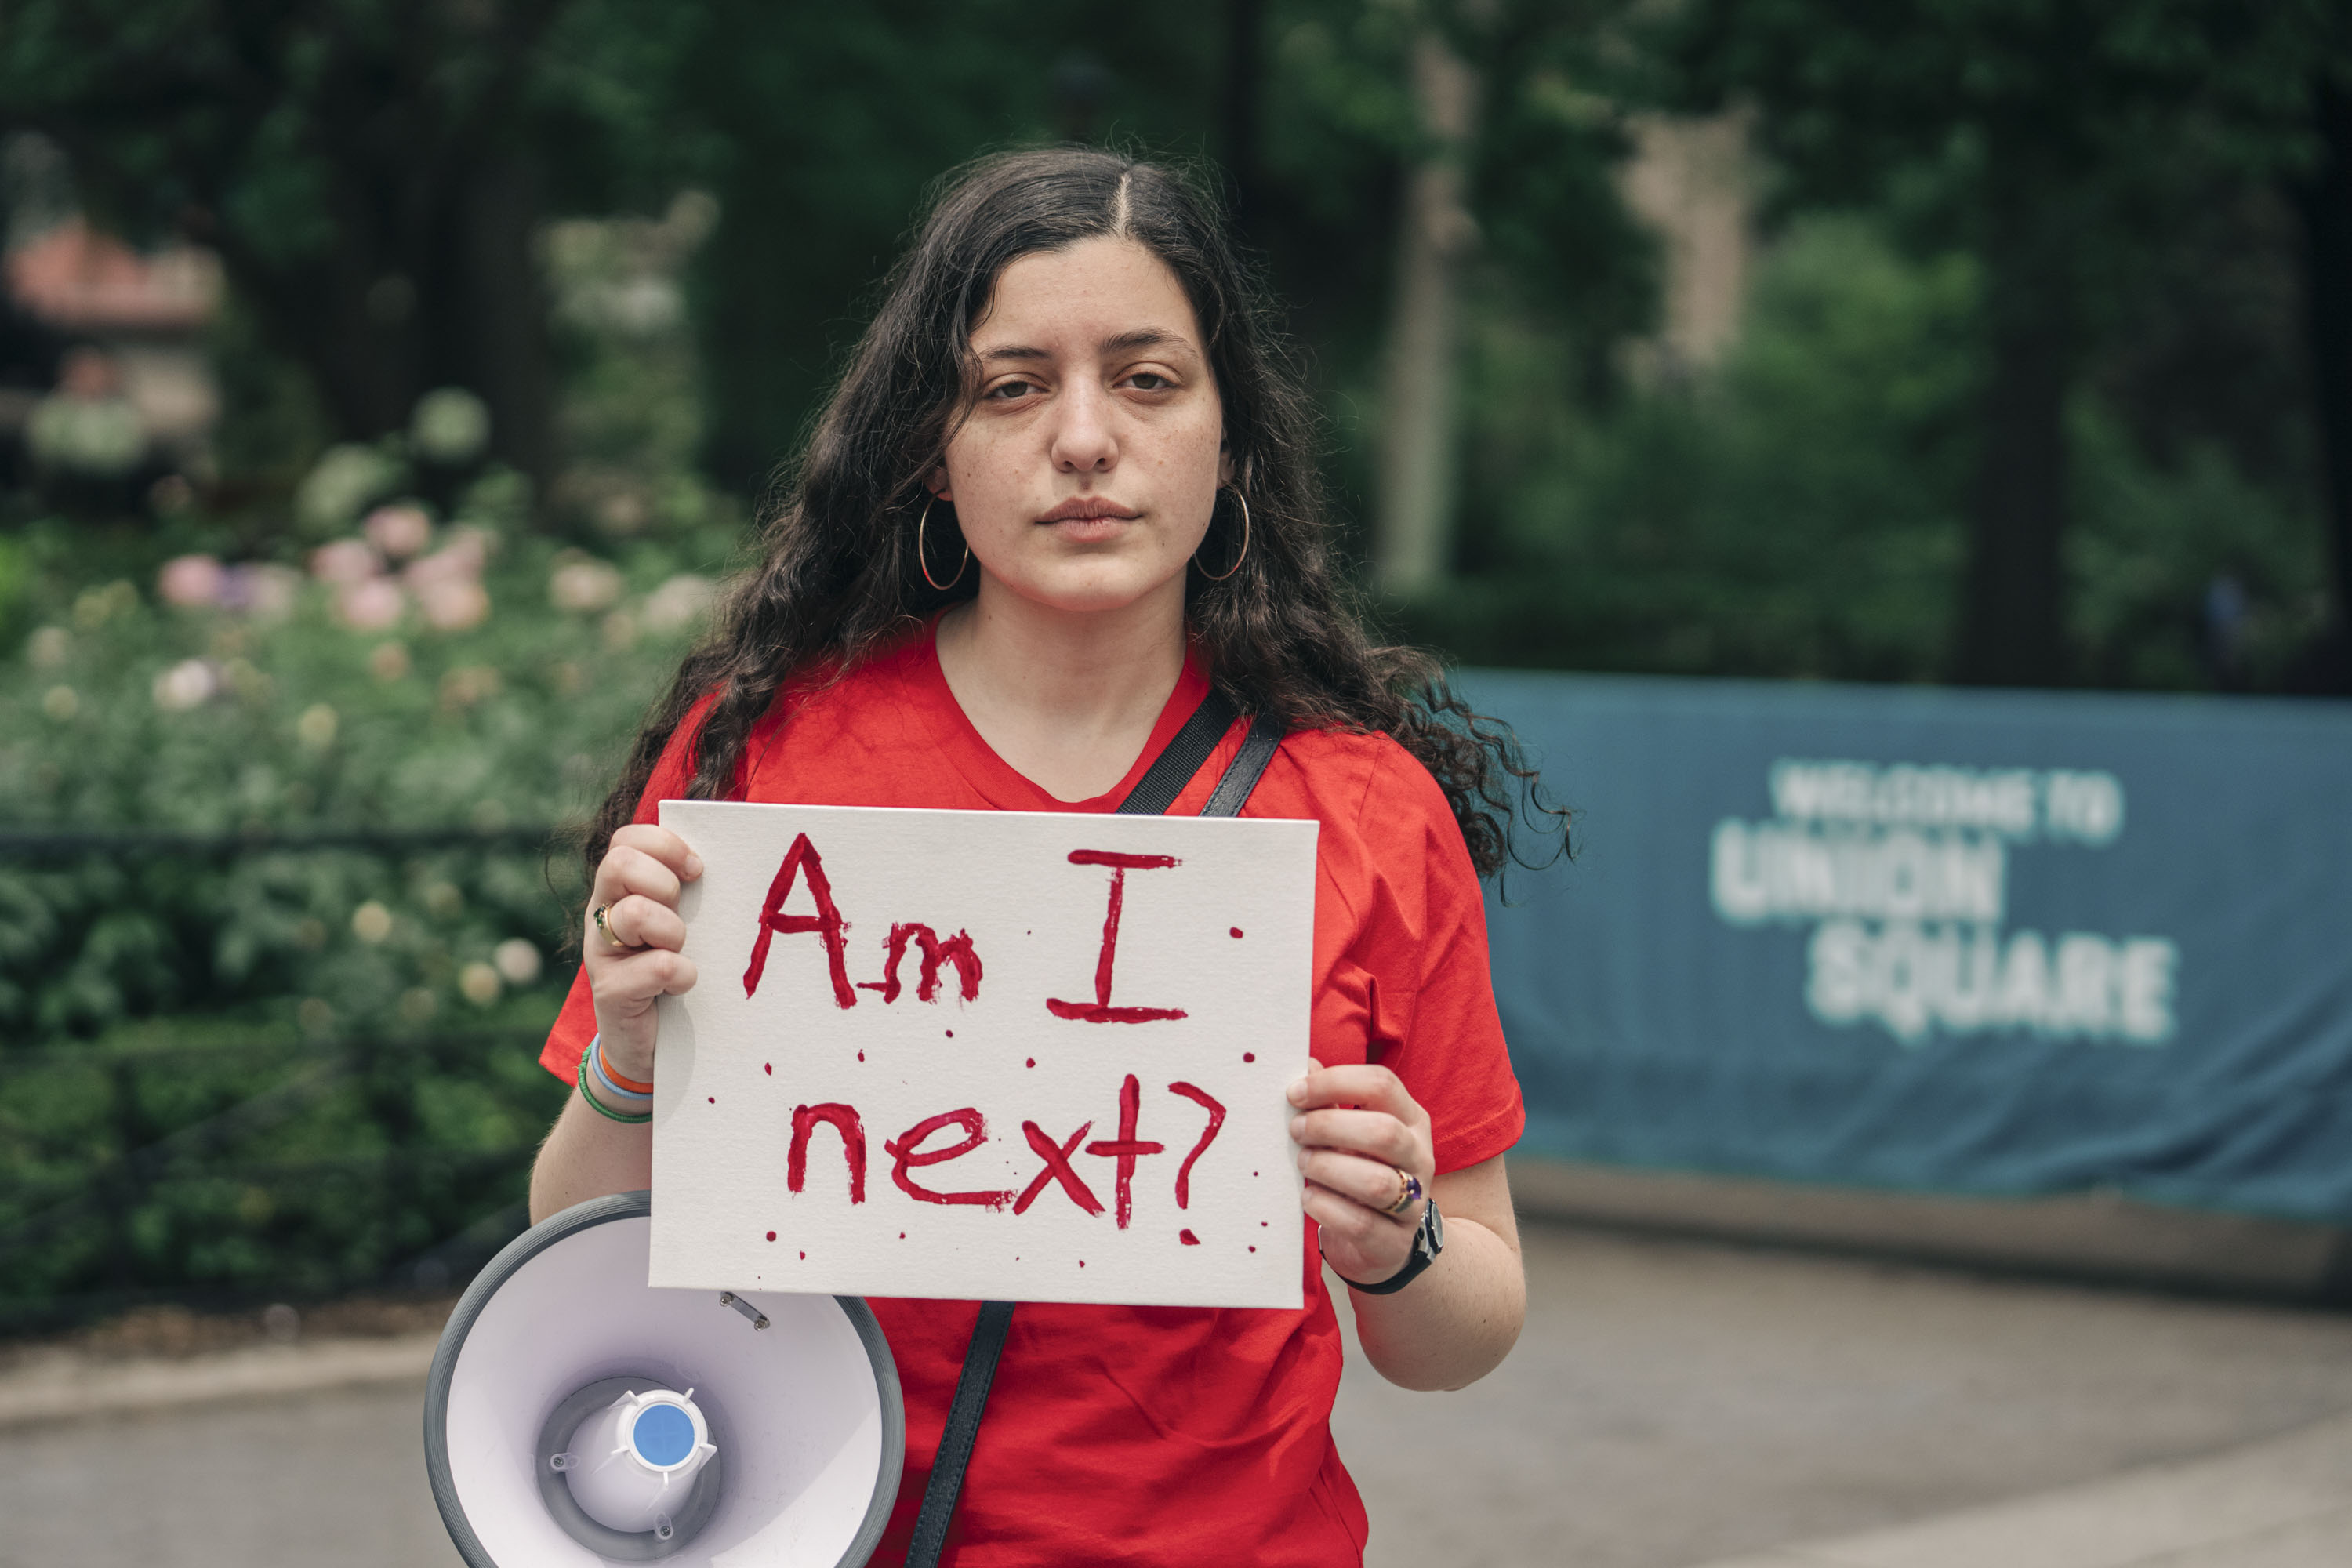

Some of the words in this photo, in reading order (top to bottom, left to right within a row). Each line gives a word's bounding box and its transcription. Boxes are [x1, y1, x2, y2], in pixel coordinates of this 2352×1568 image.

[1770, 760, 2036, 840] WELCOME
[2045, 770, 2122, 844] TO
[743, 833, 983, 1009] Am
[1047, 849, 1189, 1024] I
[1712, 820, 2004, 925] UNION
[1808, 922, 2176, 1044] SQUARE
[788, 1074, 1227, 1245] next?
